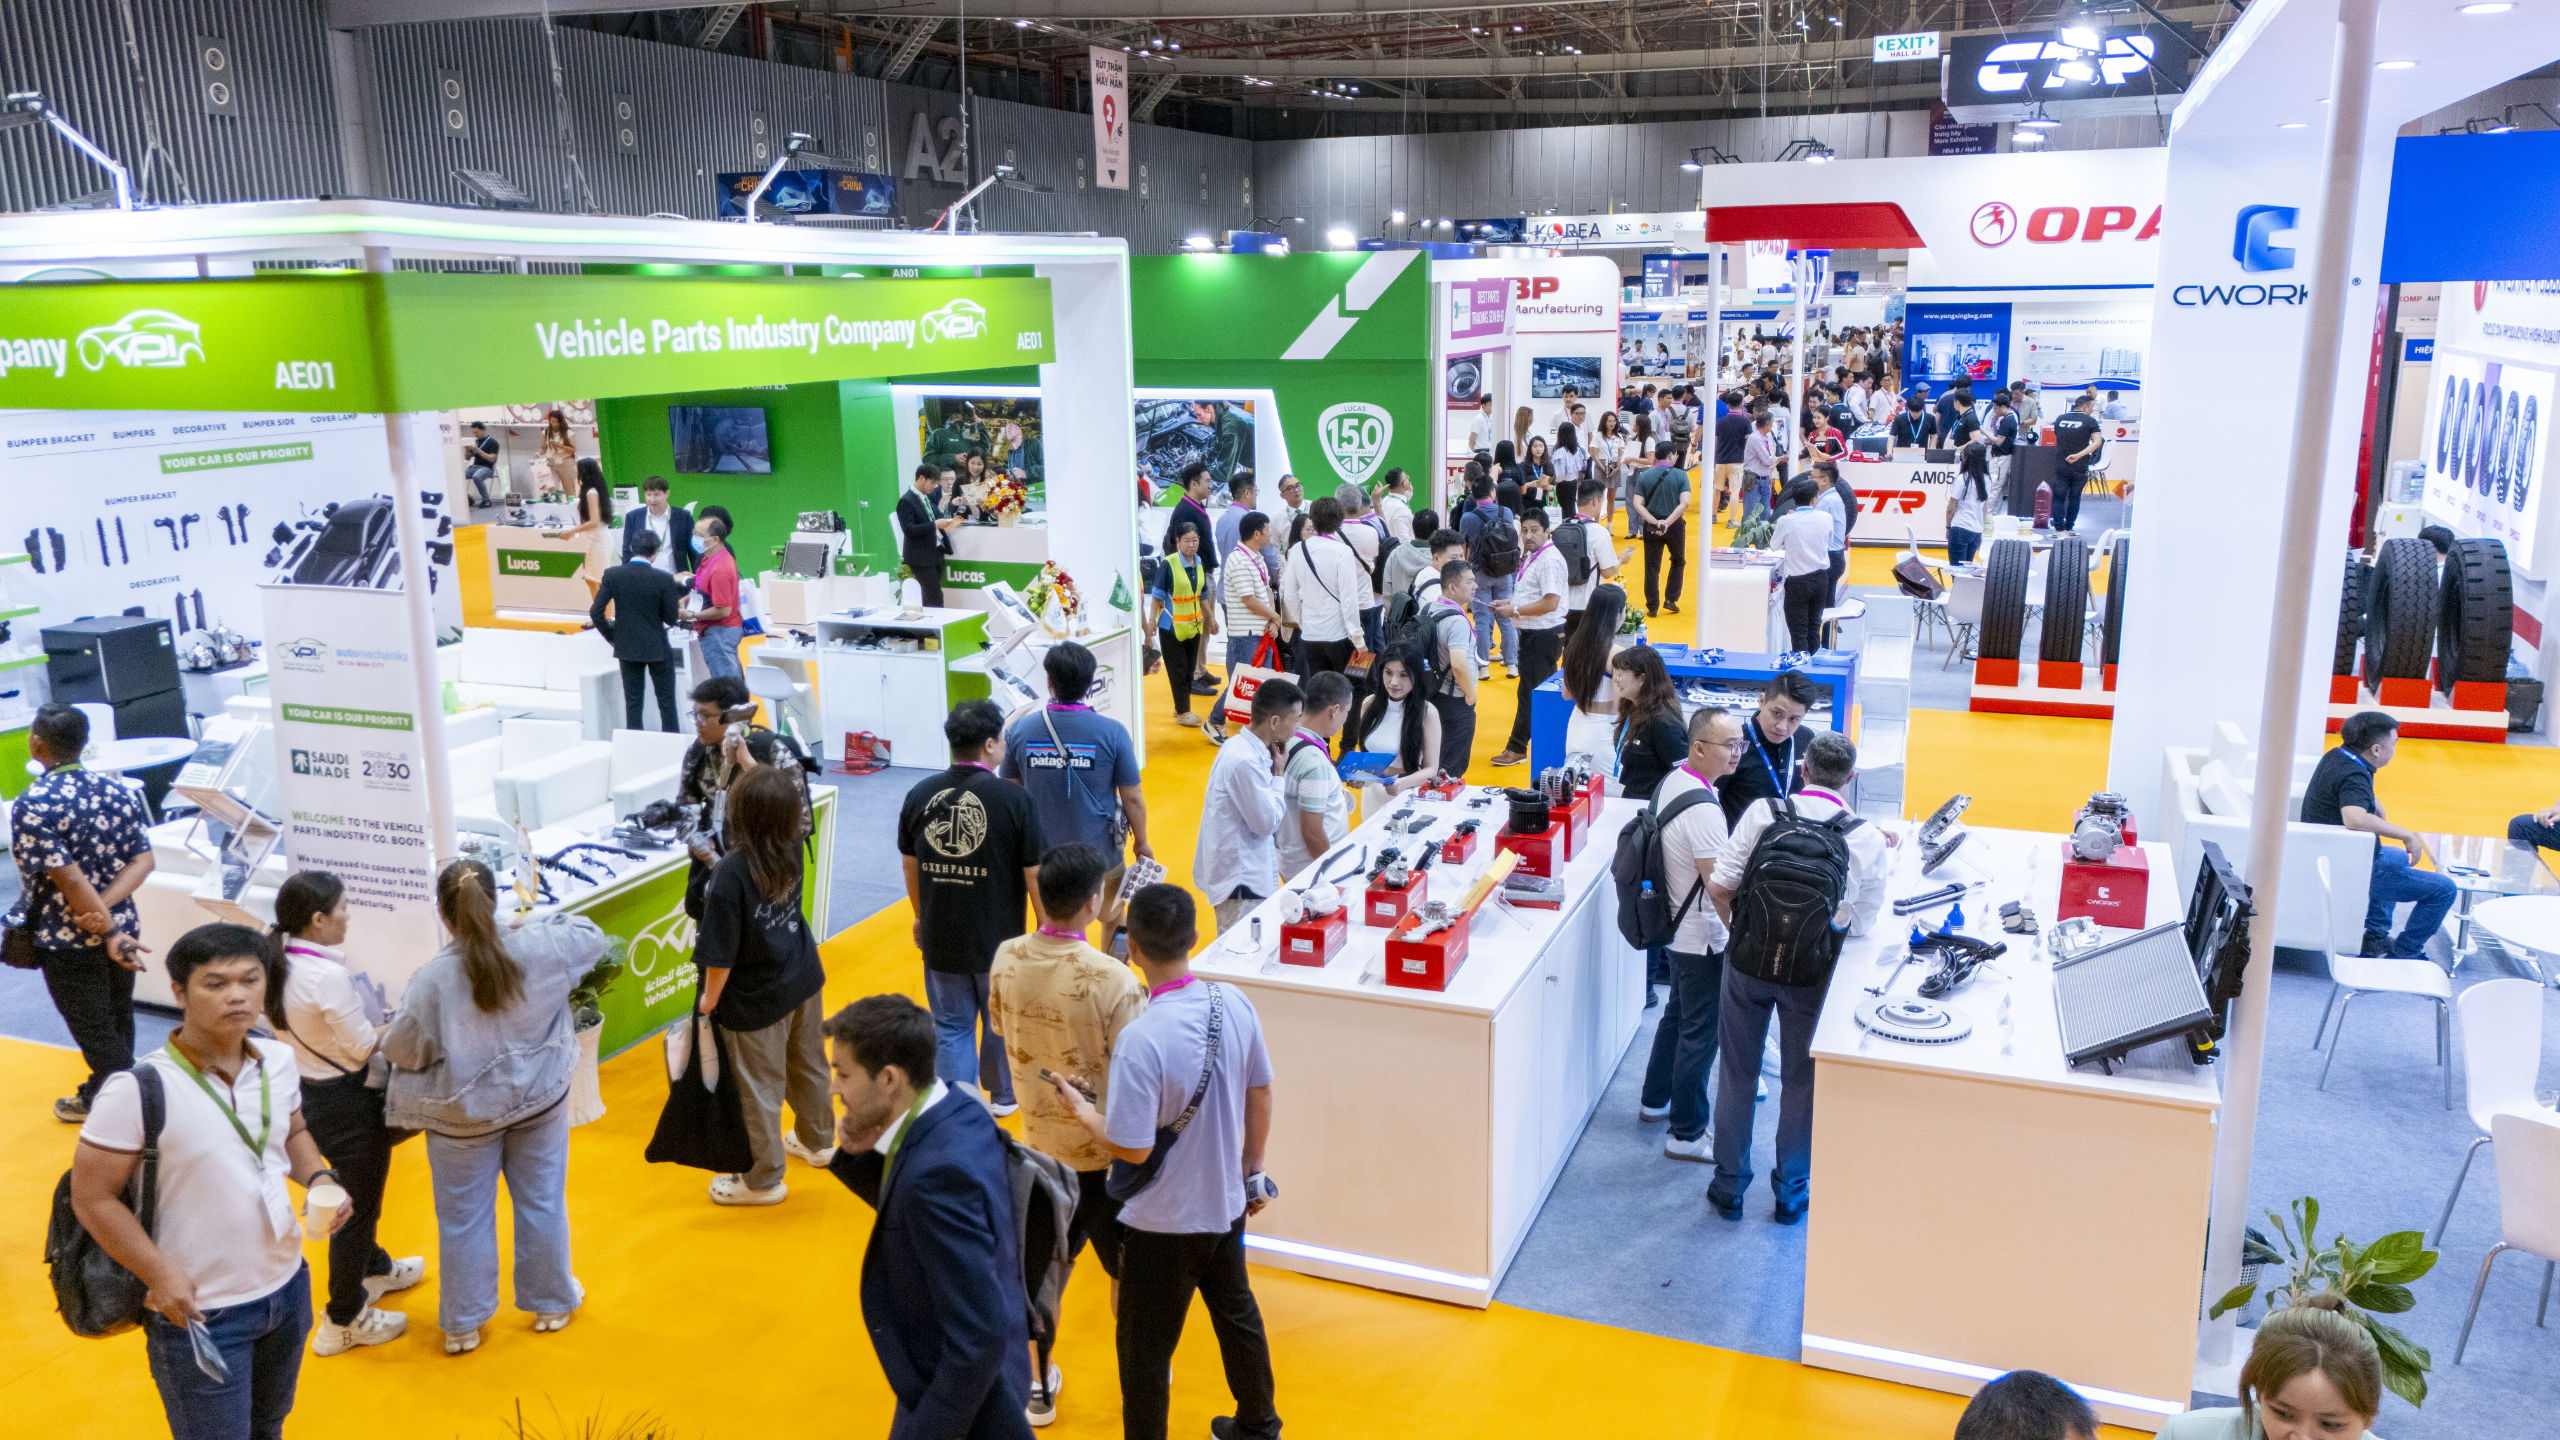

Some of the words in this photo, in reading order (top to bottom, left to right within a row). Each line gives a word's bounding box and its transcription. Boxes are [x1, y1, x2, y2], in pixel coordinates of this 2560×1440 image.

[1885, 36, 1925, 52] EXIT
[1911, 49, 1922, 57] A2
[1106, 103, 1113, 122] 2
[904, 112, 967, 184] A2
[842, 181, 864, 192] CHINA
[1535, 222, 1602, 240] KOREA
[893, 267, 919, 279] AN01
[535, 319, 646, 360] Vehicle
[653, 318, 722, 355] Parts
[727, 315, 820, 354] Industry
[825, 314, 916, 349] Company
[1016, 331, 1043, 351] AE01
[274, 360, 336, 391] AE01
[242, 419, 276, 429] BUMPER
[277, 417, 296, 427] SIDE
[310, 414, 336, 424] COVER
[338, 412, 358, 422] LAMP
[2058, 420, 2083, 429] CTR
[112, 428, 155, 440] BUMPERS
[172, 423, 227, 435] DECORATIVE
[1328, 418, 1383, 450] 150
[7, 437, 48, 448] BUMPER
[51, 433, 95, 445] BRACKET
[164, 454, 196, 470] YOUR
[198, 452, 223, 468] CAR
[223, 451, 234, 464] IS
[235, 449, 258, 463] OUR
[260, 445, 310, 461] PRIORITY
[1910, 470, 1956, 485] AM05
[104, 495, 135, 506] BUMPER
[137, 491, 177, 503] BRACKET
[506, 554, 541, 572] Lucas
[946, 566, 986, 583] Lucas
[129, 575, 181, 590] DECORATIVE
[288, 707, 311, 718] YOUR
[312, 709, 333, 720] CAR
[334, 711, 344, 721] IS
[344, 712, 363, 723] OUR
[364, 714, 410, 727] PRIORITY
[311, 752, 349, 765] SAUDI
[313, 766, 350, 779] MADE
[292, 811, 345, 826] WELCOME
[347, 817, 360, 827] TO
[363, 818, 380, 830] THE
[384, 822, 424, 834] VEHICLE
[293, 825, 322, 837] PARTS
[323, 829, 370, 842] INDUSTRY
[372, 834, 390, 845] CO.
[391, 836, 425, 847] BOOTH
[297, 853, 310, 862] We
[312, 856, 325, 865] are
[326, 856, 360, 870] pleased
[360, 861, 370, 870] to
[371, 863, 406, 875] connect
[408, 866, 428, 876] with
[381, 877, 397, 886] our
[358, 886, 406, 899] automotive
[2086, 899, 2120, 908] CWORKS
[644, 985, 676, 1008] Vehicle
